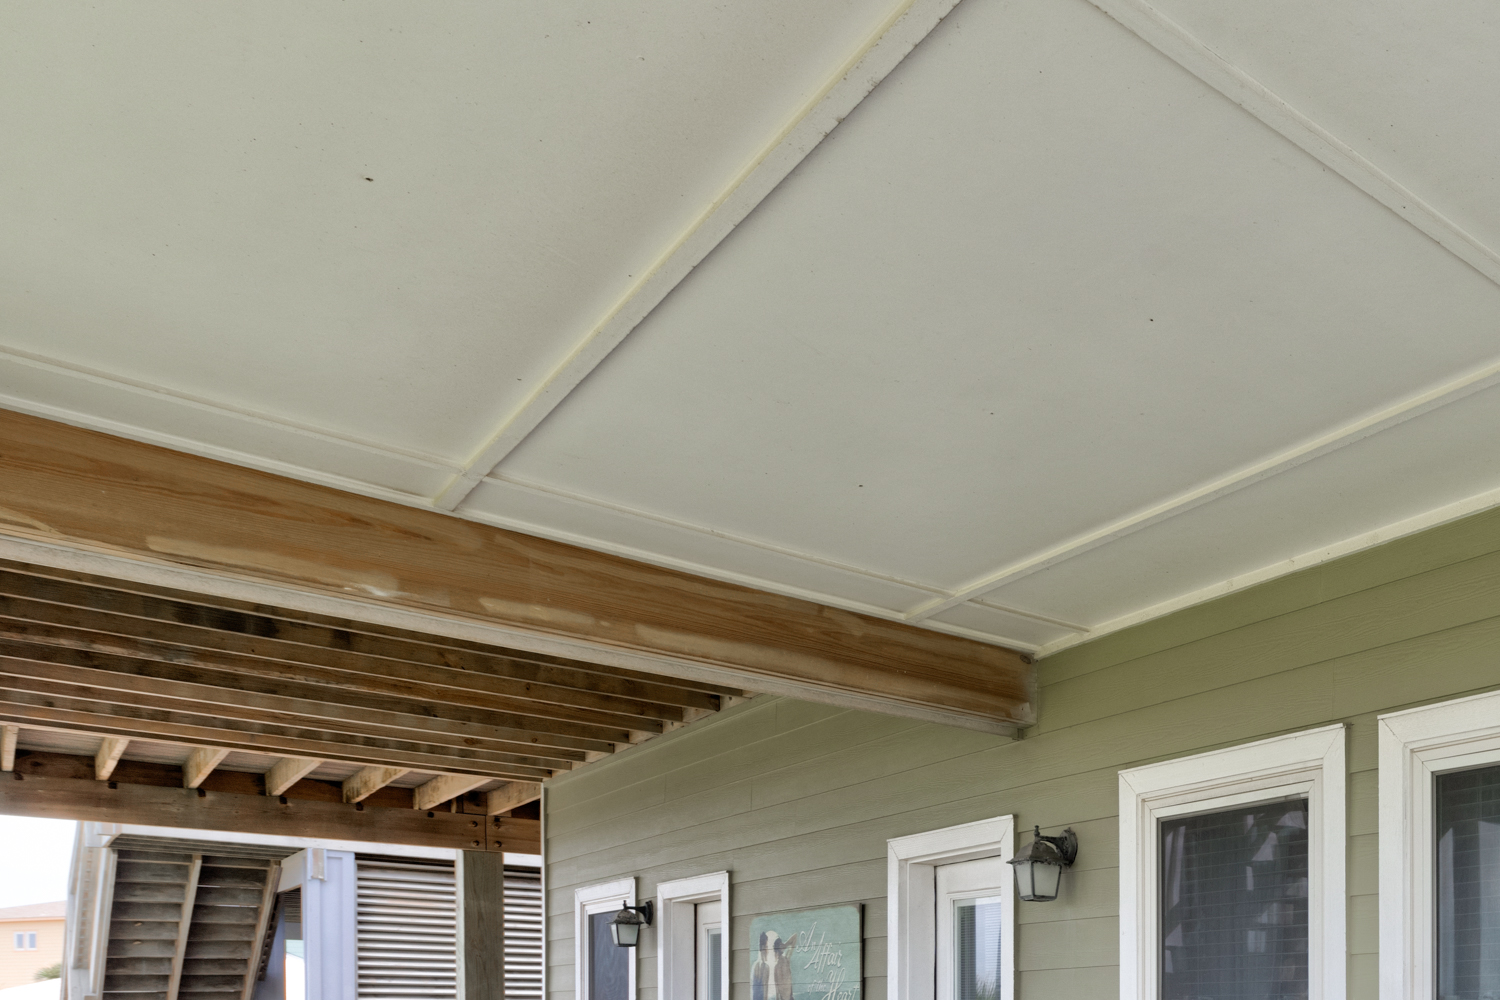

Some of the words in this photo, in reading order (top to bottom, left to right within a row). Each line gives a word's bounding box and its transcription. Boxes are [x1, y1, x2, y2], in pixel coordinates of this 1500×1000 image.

[796, 921, 817, 953] An
[804, 931, 842, 973] Affair
[807, 980, 816, 995] of
[816, 979, 827, 993] the
